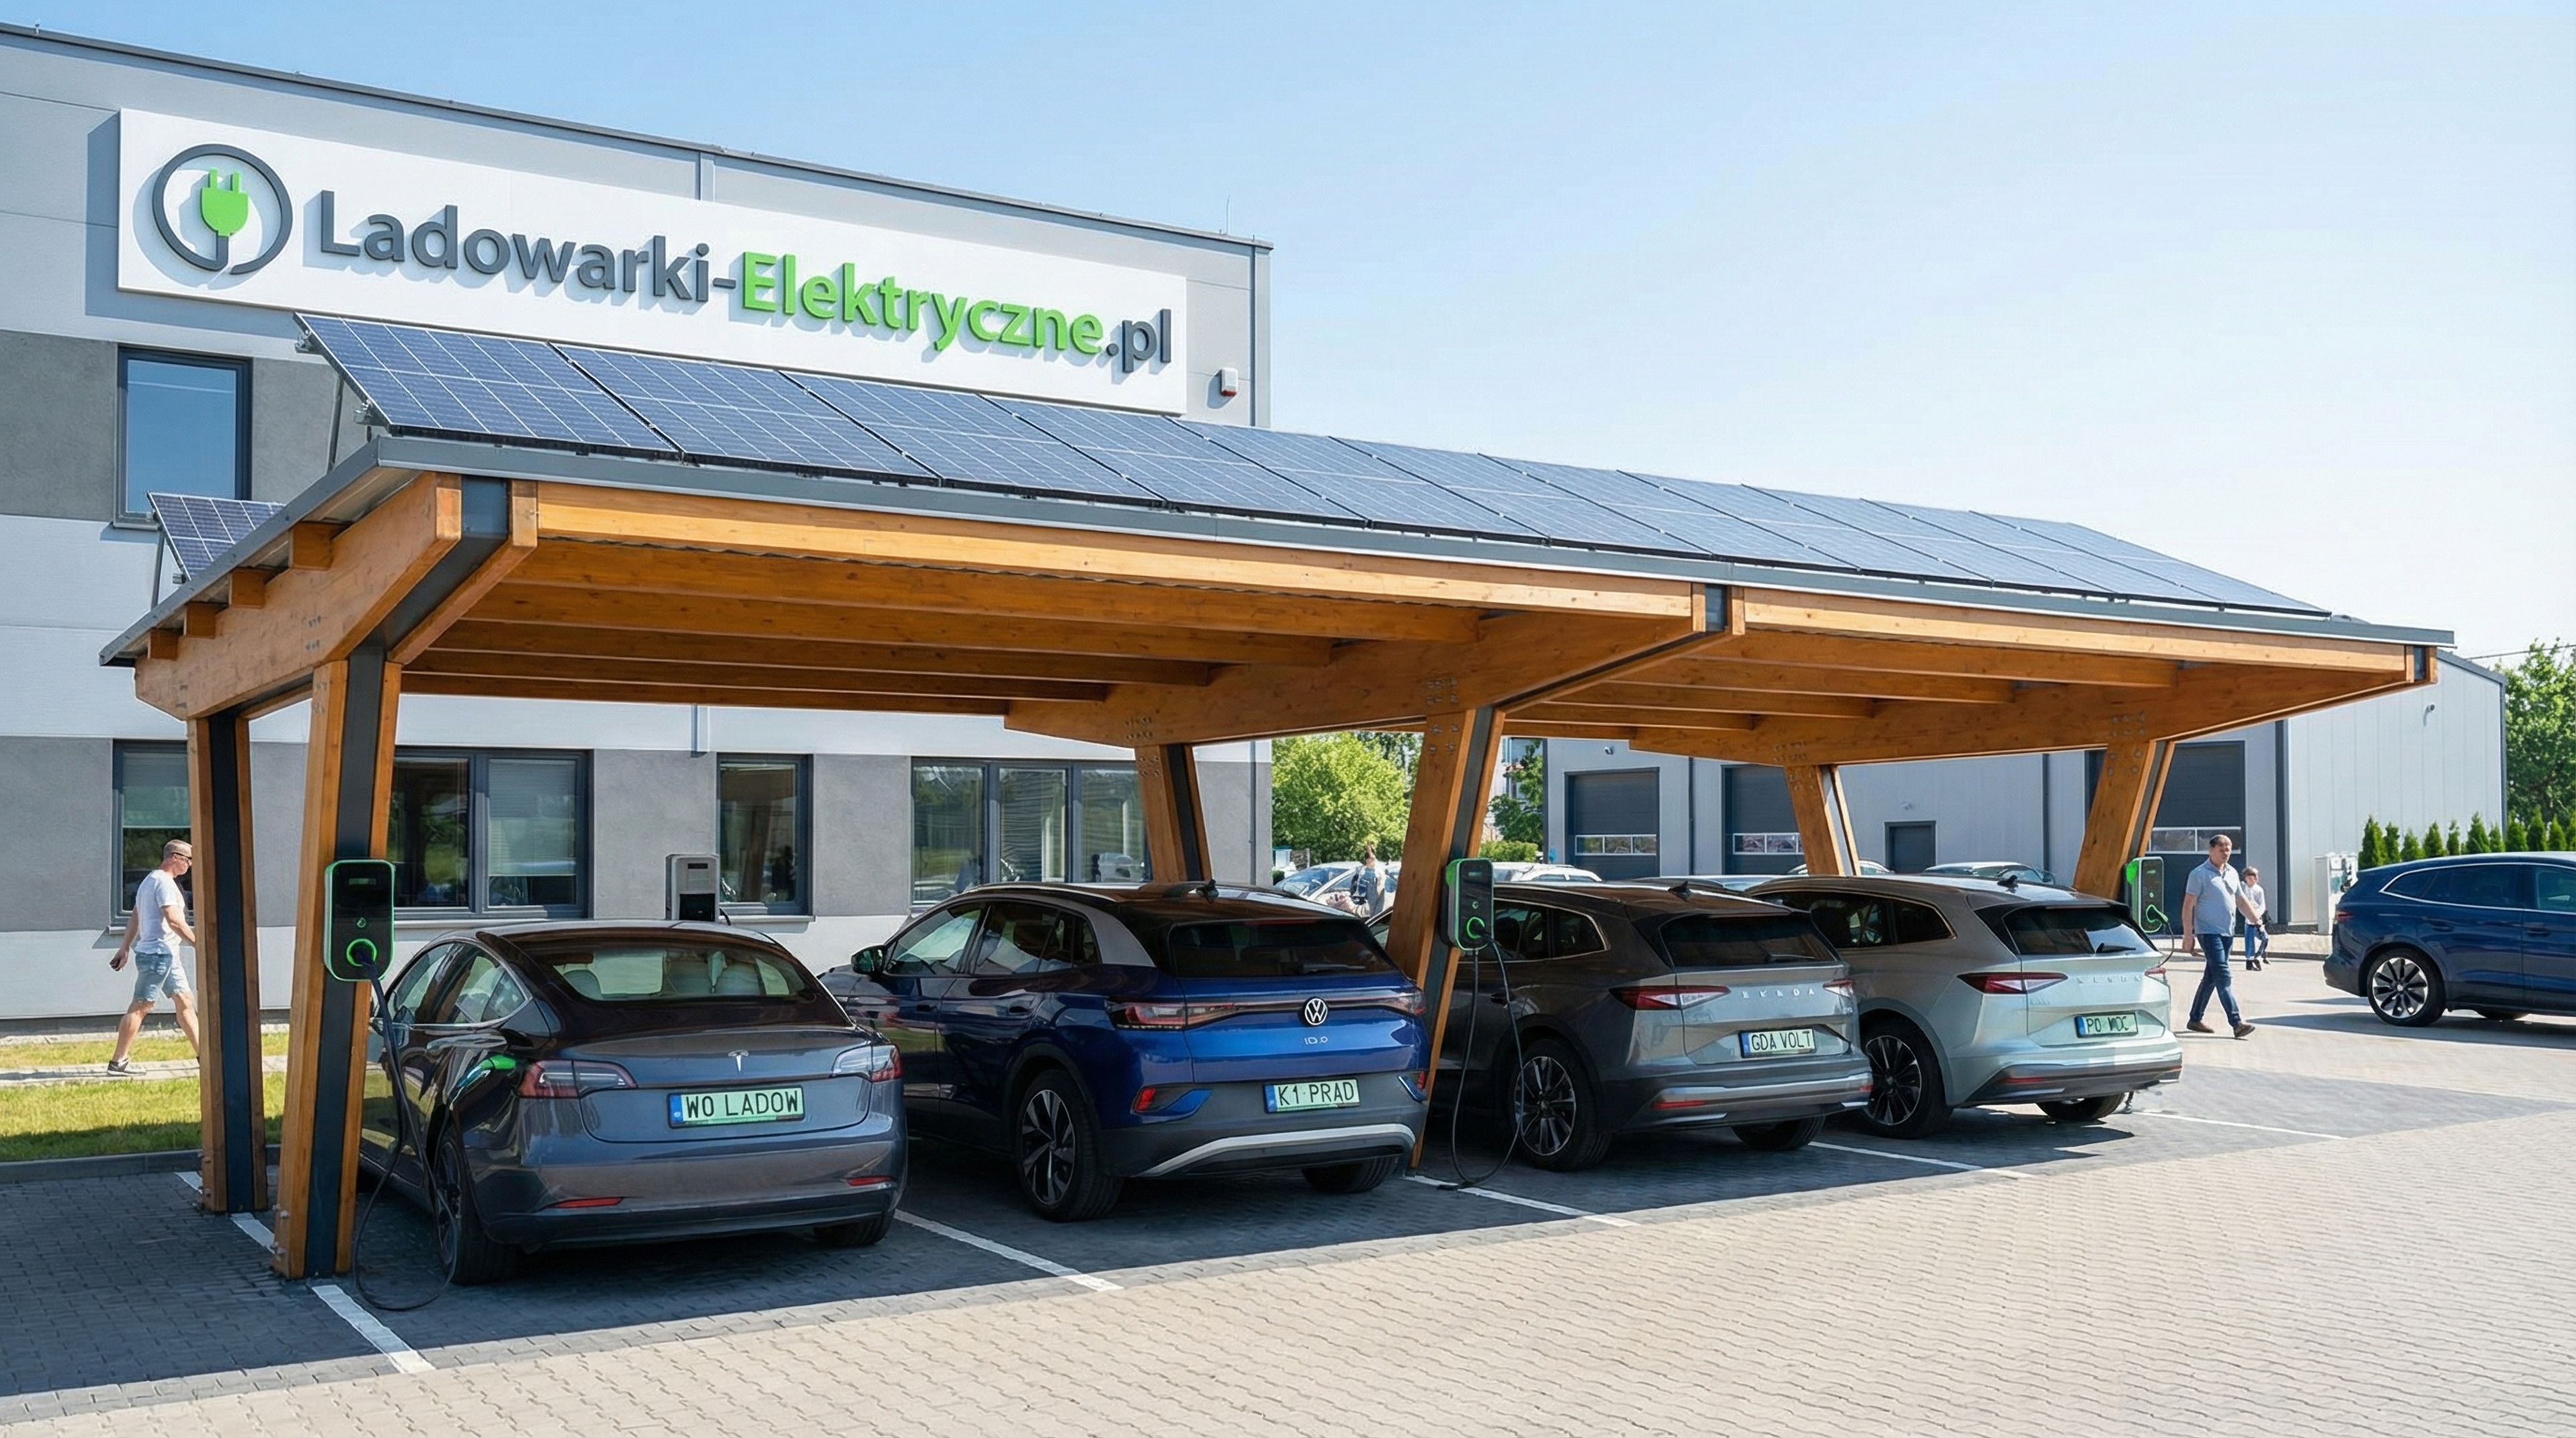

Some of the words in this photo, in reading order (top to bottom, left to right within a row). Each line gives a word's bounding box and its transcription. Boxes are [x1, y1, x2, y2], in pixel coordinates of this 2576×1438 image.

[321, 190, 1172, 373] Ladowarki-Elektryczne.pl
[2086, 1018, 2102, 1033] PO
[1751, 1032, 1777, 1051] GDA
[1780, 1030, 1811, 1048] VOLT
[686, 1095, 714, 1118] WO
[724, 1090, 798, 1116] LADOW
[1278, 1085, 1299, 1106] K1
[1309, 1082, 1354, 1102] PRAD
